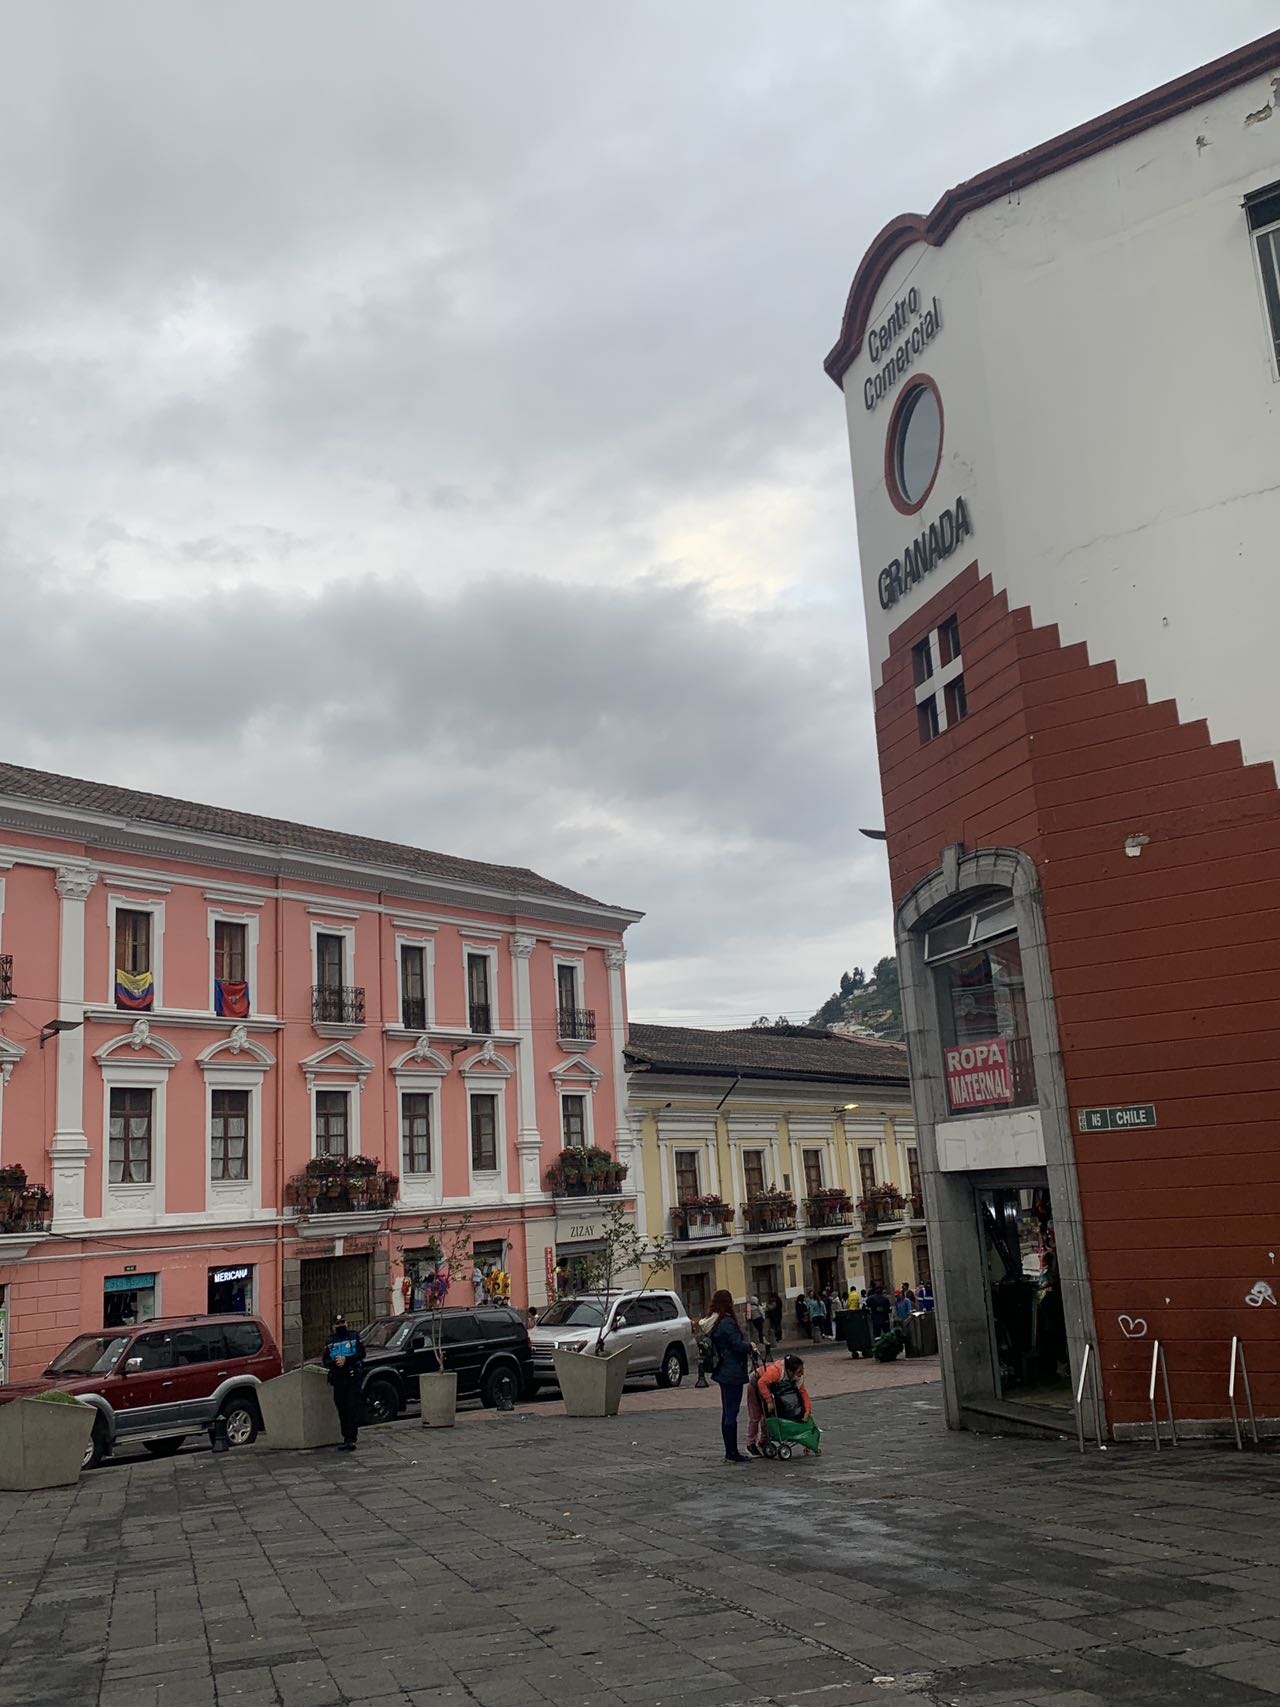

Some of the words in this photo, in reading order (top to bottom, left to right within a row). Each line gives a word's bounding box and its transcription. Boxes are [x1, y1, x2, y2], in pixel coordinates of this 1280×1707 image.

[868, 287, 917, 362] Centro
[864, 296, 939, 409] Comercial
[878, 496, 969, 609] GRANADA
[947, 1043, 1003, 1071] ROPA
[950, 1068, 1010, 1104] MATERNAL
[1116, 1109, 1147, 1124] CHILE
[570, 1225, 594, 1237] ZIZAY
